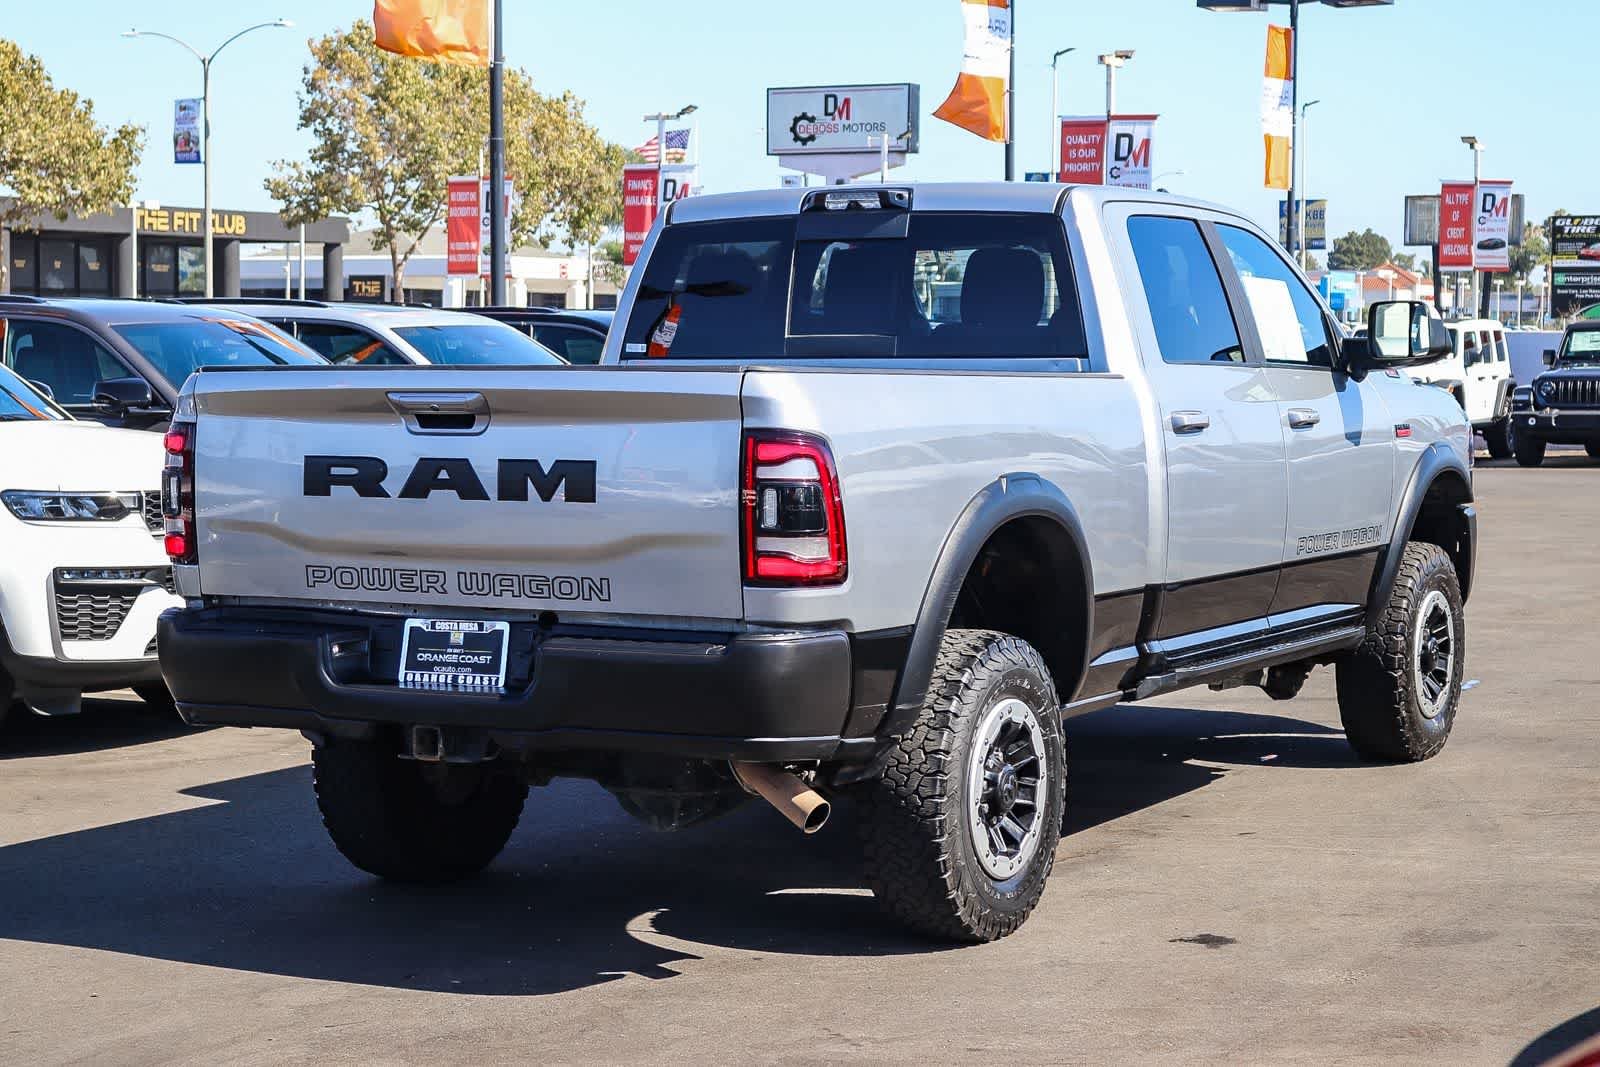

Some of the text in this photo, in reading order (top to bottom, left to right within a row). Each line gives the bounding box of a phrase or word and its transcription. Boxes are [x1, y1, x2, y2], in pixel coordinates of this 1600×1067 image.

[842, 122, 886, 133] MOTORS
[1066, 134, 1101, 144] QUALITY
[1069, 149, 1096, 158] IS OUR
[1064, 162, 1100, 173] PRIORITY
[628, 180, 654, 190] FINANCE
[625, 195, 656, 206] AVAILABLE
[1446, 193, 1469, 205] ALL TYPE
[136, 209, 169, 231] THE
[173, 212, 201, 232] FIT
[1452, 211, 1460, 221] OF
[1447, 228, 1465, 239] CREDIT
[1443, 244, 1469, 256] WELCOME
[352, 281, 381, 293] THE
[303, 455, 597, 503] RAM
[1296, 525, 1383, 555] POWER WAGON
[305, 565, 611, 601] POWER WAGON
[435, 622, 479, 631] COSTA MESA
[417, 653, 492, 664] ORANGE COAST
[406, 673, 498, 686] ORANGE COAST
